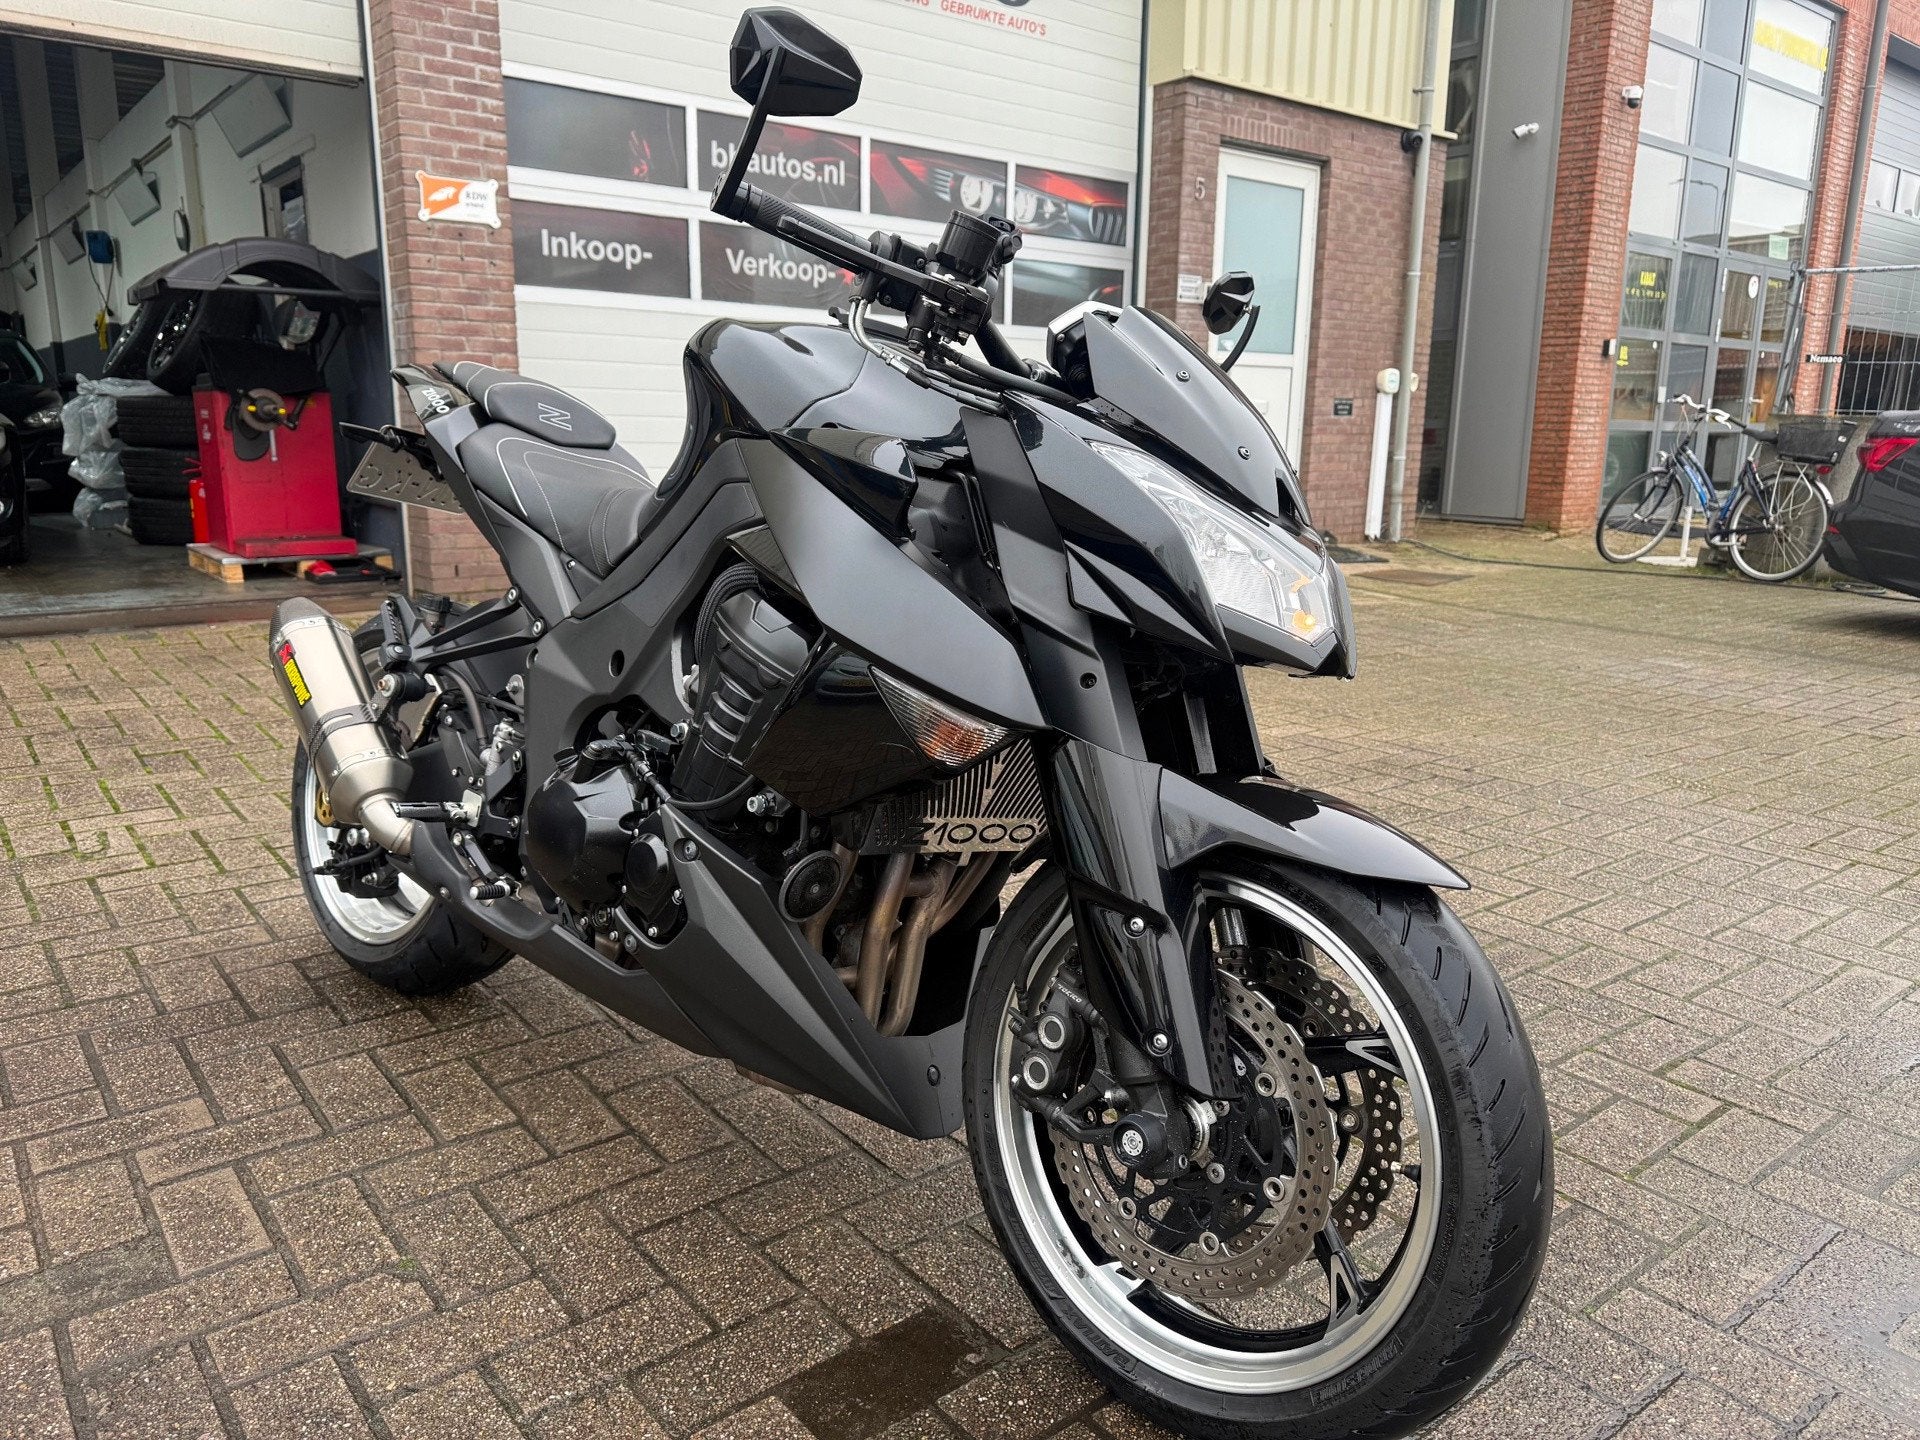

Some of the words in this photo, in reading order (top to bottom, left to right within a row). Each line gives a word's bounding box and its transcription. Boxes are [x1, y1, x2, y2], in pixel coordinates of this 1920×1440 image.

[940, 0, 1006, 26] GEBRUIKTE
[1007, 16, 1046, 36] AUTO'S
[1194, 177, 1206, 200] 5
[541, 228, 653, 271] Inkoop-
[725, 247, 836, 288] Verkoop-
[421, 387, 450, 414] Z1000
[909, 822, 1036, 846] Z1000
